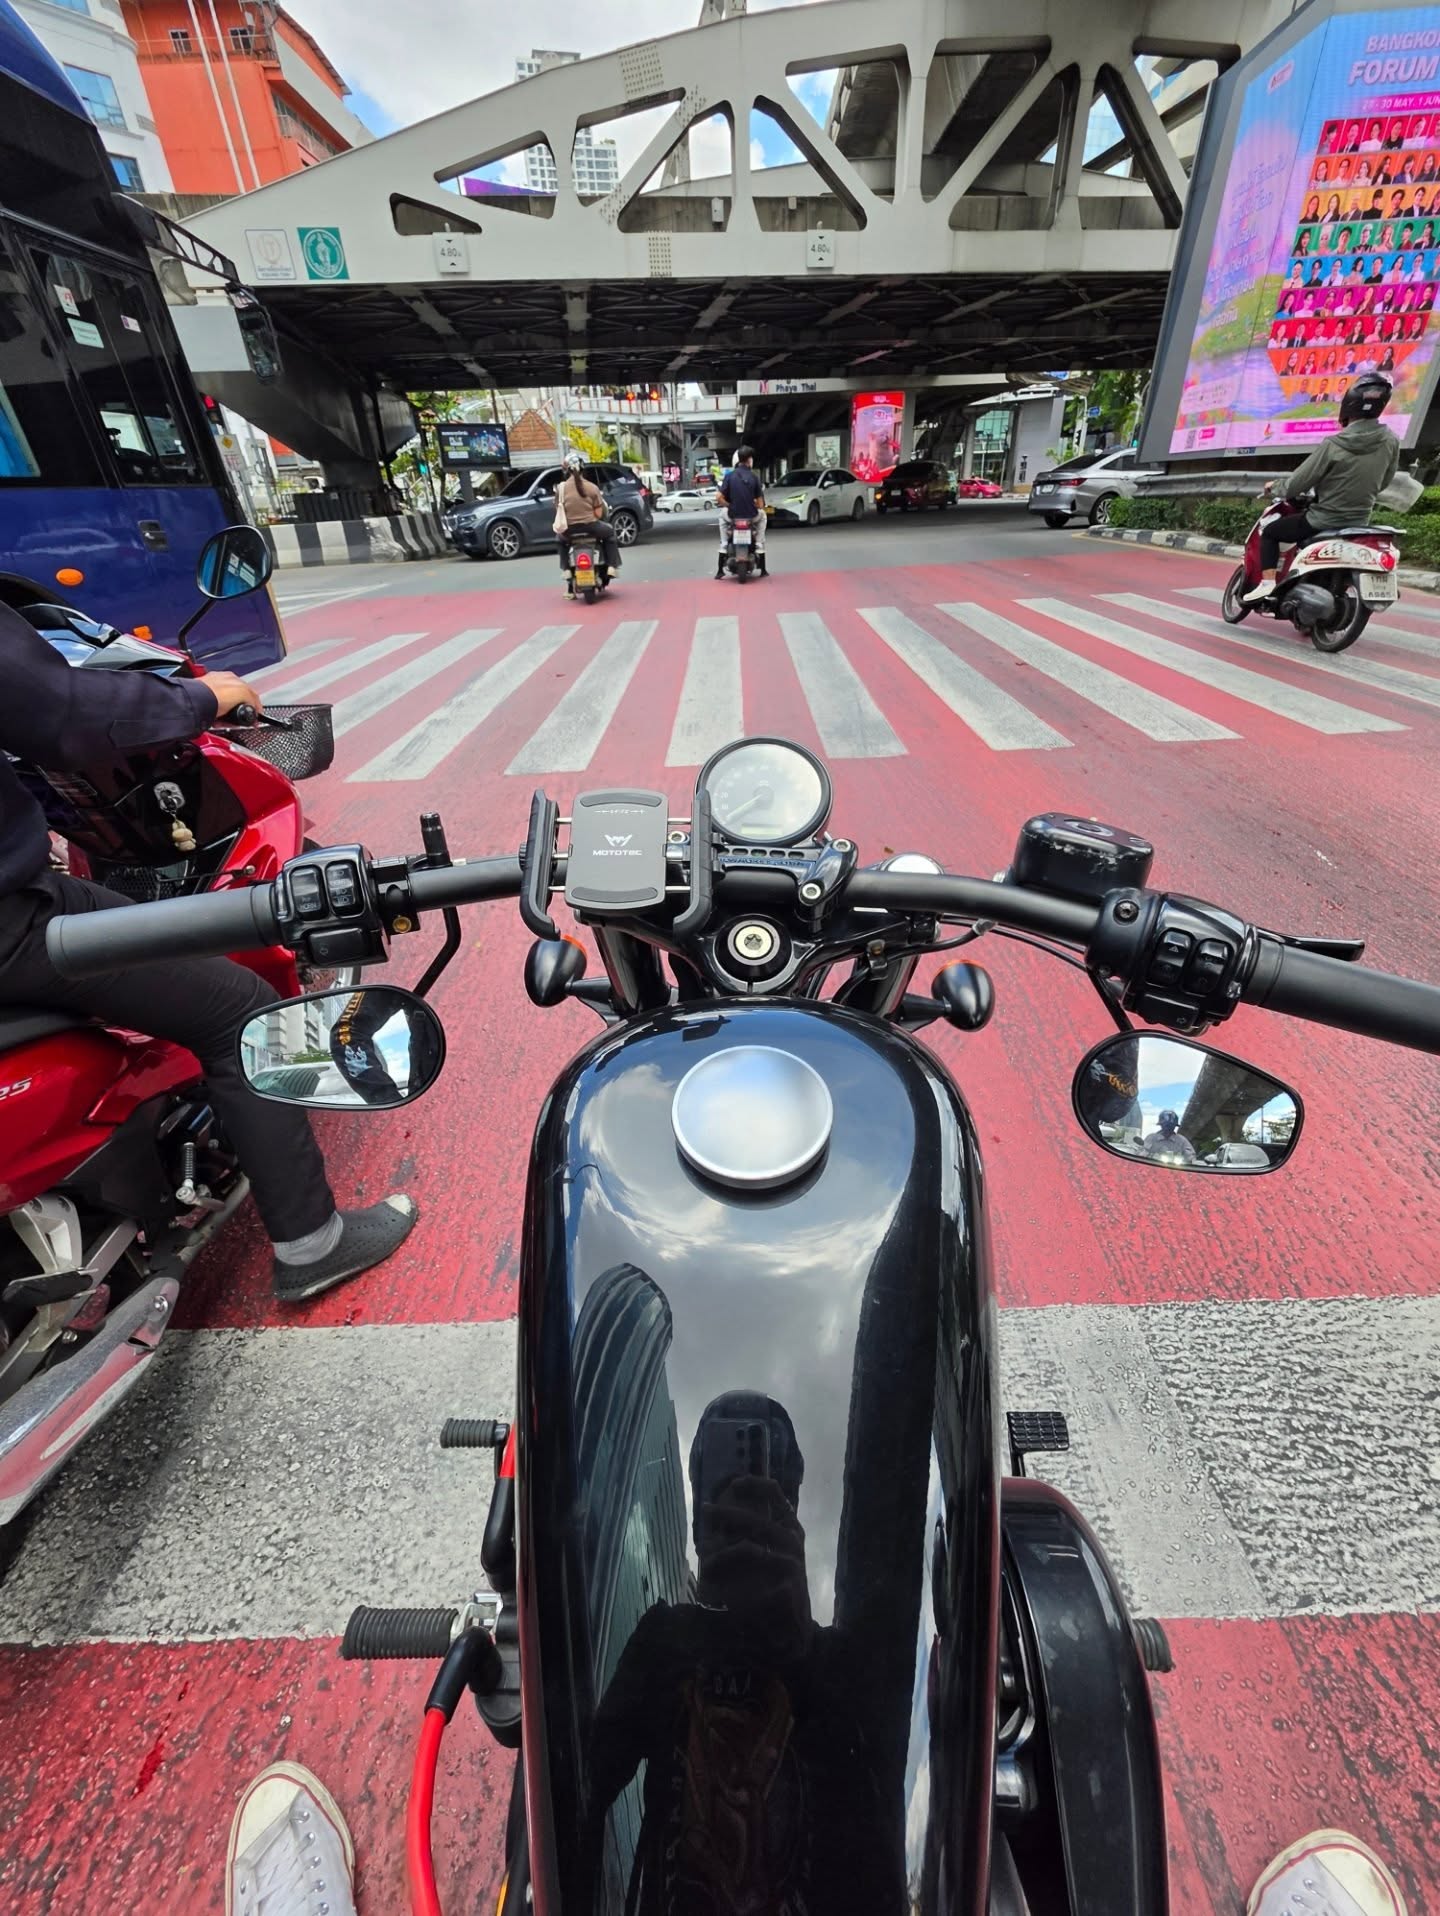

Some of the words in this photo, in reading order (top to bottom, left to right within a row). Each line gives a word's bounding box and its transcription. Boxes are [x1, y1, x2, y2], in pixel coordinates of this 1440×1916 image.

[1347, 56, 1439, 87] FORUM
[776, 383, 797, 394] Phaya
[801, 382, 816, 391] Thai
